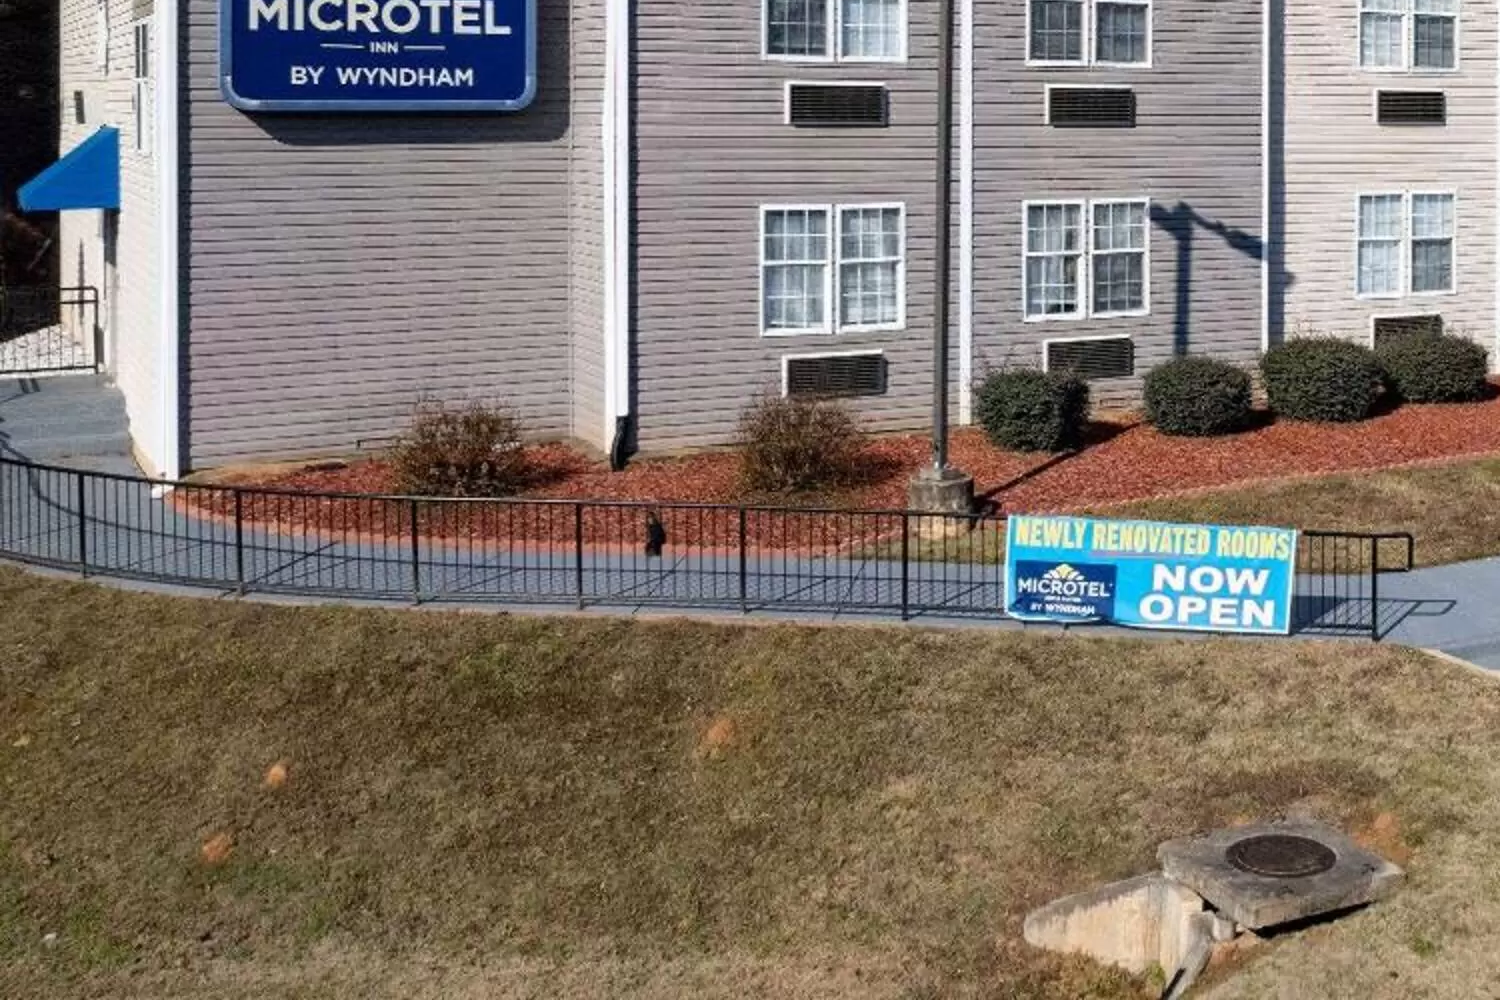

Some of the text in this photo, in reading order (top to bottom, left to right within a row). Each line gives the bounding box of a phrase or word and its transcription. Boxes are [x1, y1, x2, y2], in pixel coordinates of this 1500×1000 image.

[369, 41, 399, 54] INN
[290, 66, 474, 87] BY WYNDHAM
[1014, 518, 1290, 560] NEWLY RENOVATED ROOMS
[1017, 577, 1111, 597] MICROTEL
[1152, 563, 1270, 595] NOW
[1029, 602, 1096, 615] BY WYNDHAM
[1139, 593, 1275, 627] OPEN
